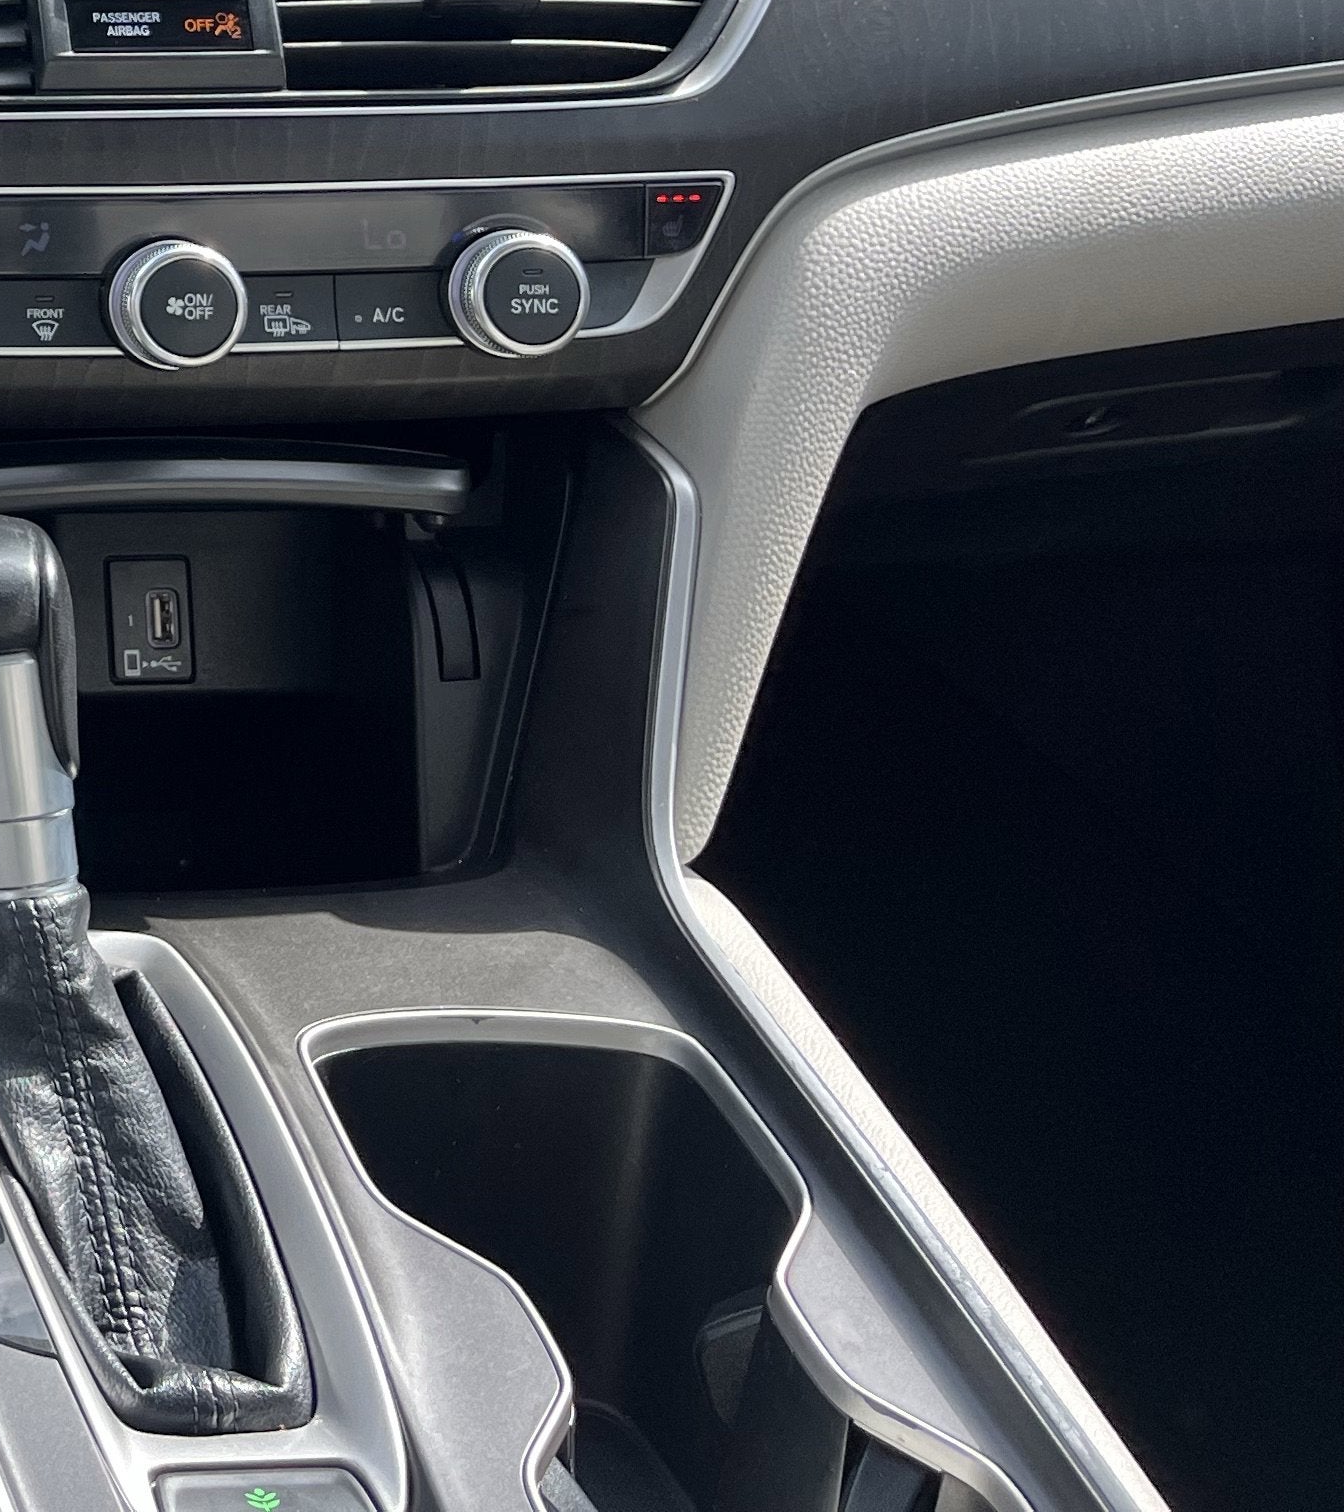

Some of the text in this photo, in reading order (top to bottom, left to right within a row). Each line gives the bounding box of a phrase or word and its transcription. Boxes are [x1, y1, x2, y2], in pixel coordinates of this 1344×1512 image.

[92, 11, 161, 24] PASSENGER
[106, 24, 151, 37] AIRBAG
[184, 18, 215, 33] OFF
[363, 219, 407, 250] Lo
[518, 284, 550, 295] PUSH
[184, 292, 214, 307] ON/
[510, 297, 560, 315] SYNC
[26, 307, 64, 320] FRONT
[184, 306, 214, 321] OFF
[259, 304, 292, 316] REAR
[372, 306, 405, 325] A/C
